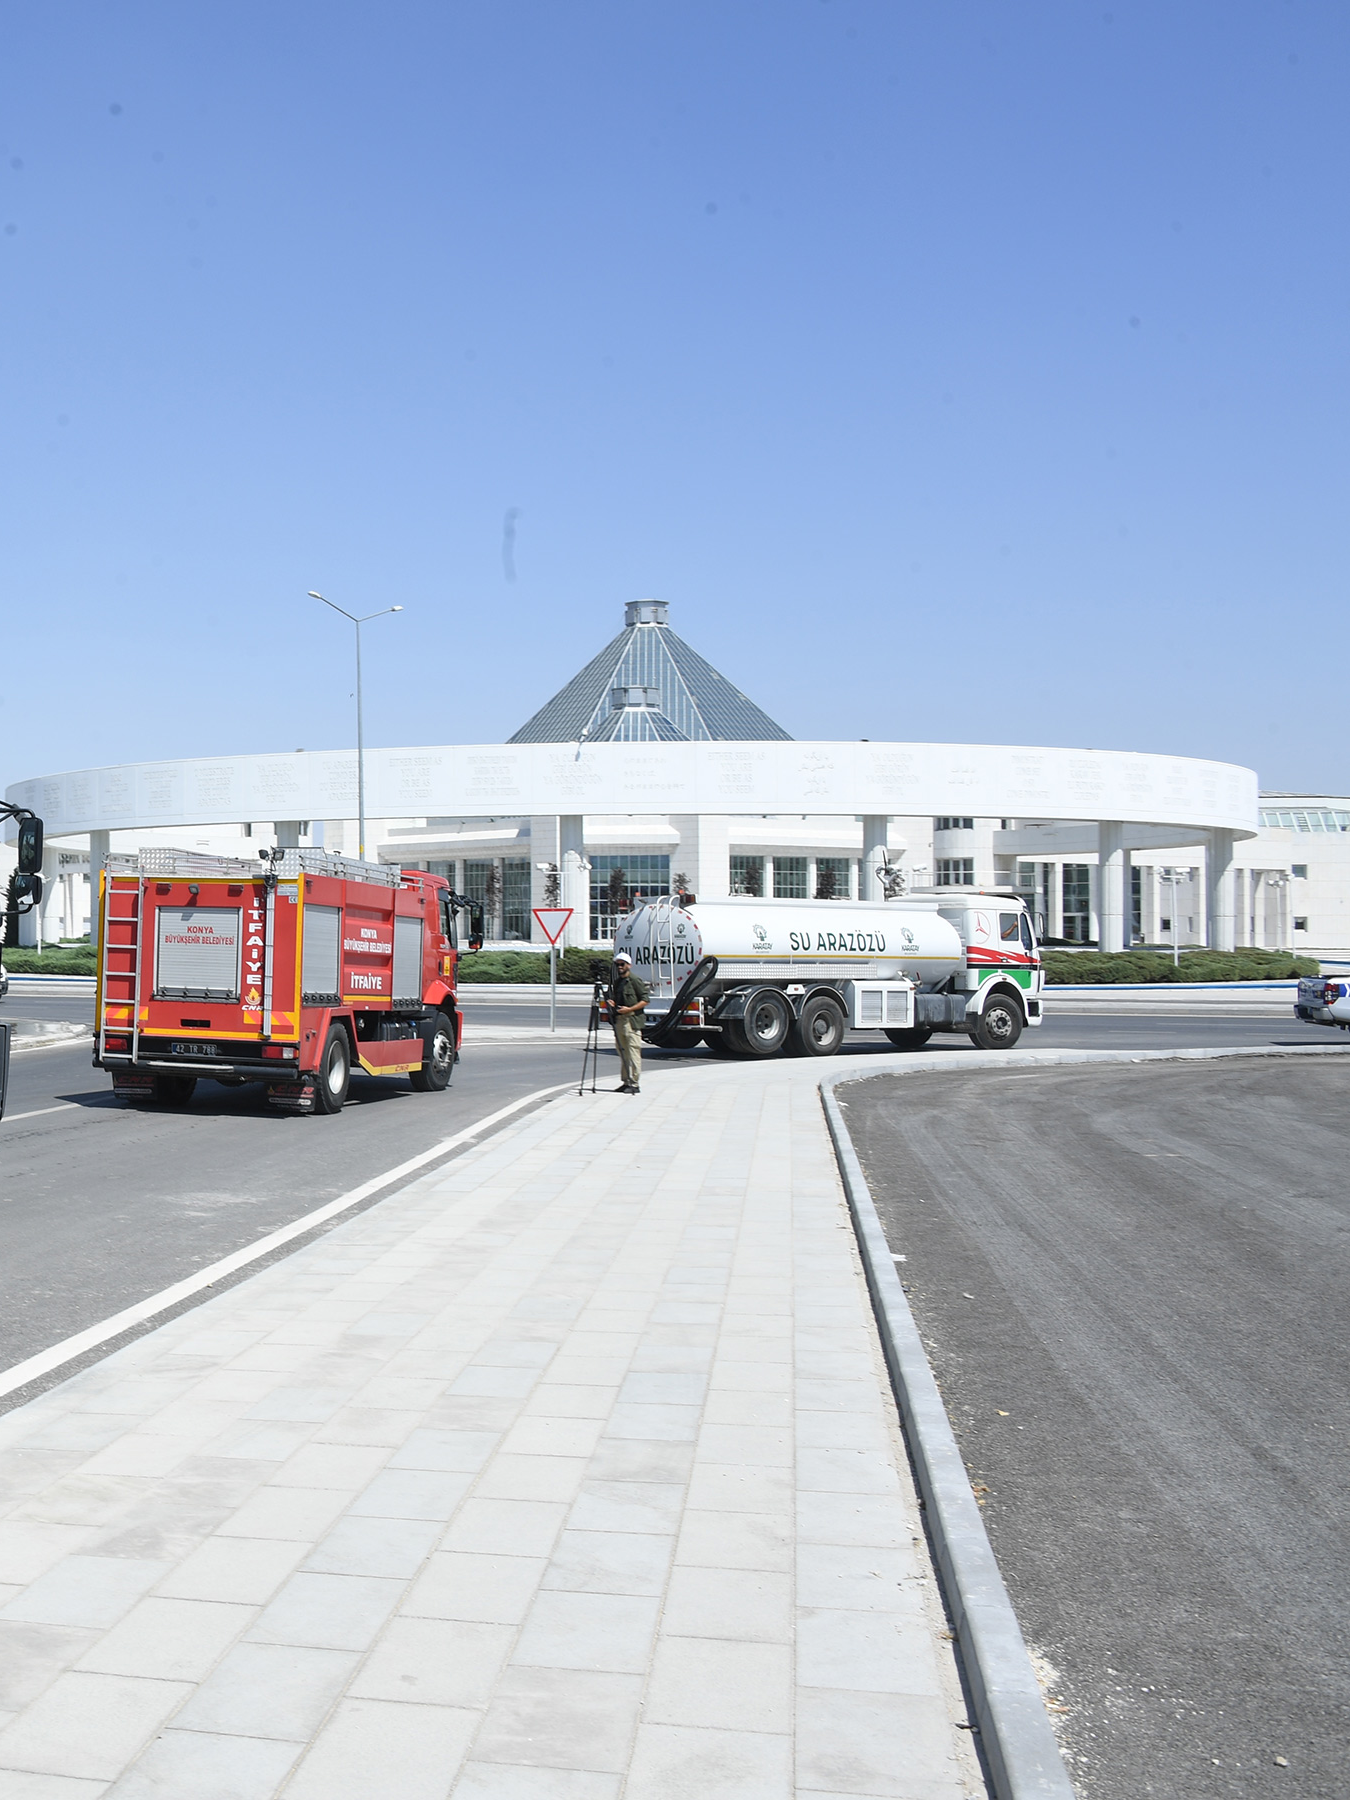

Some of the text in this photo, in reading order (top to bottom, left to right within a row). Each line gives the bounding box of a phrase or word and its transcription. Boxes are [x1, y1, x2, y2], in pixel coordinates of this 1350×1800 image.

[186, 926, 214, 934] KONYA
[360, 928, 378, 939] KONYA
[165, 934, 235, 945] BÜYÜKŞEHİR BELEDİYESİ
[789, 929, 886, 952] SU ARAZÖZÜ
[351, 971, 383, 990] İTFAİYE
